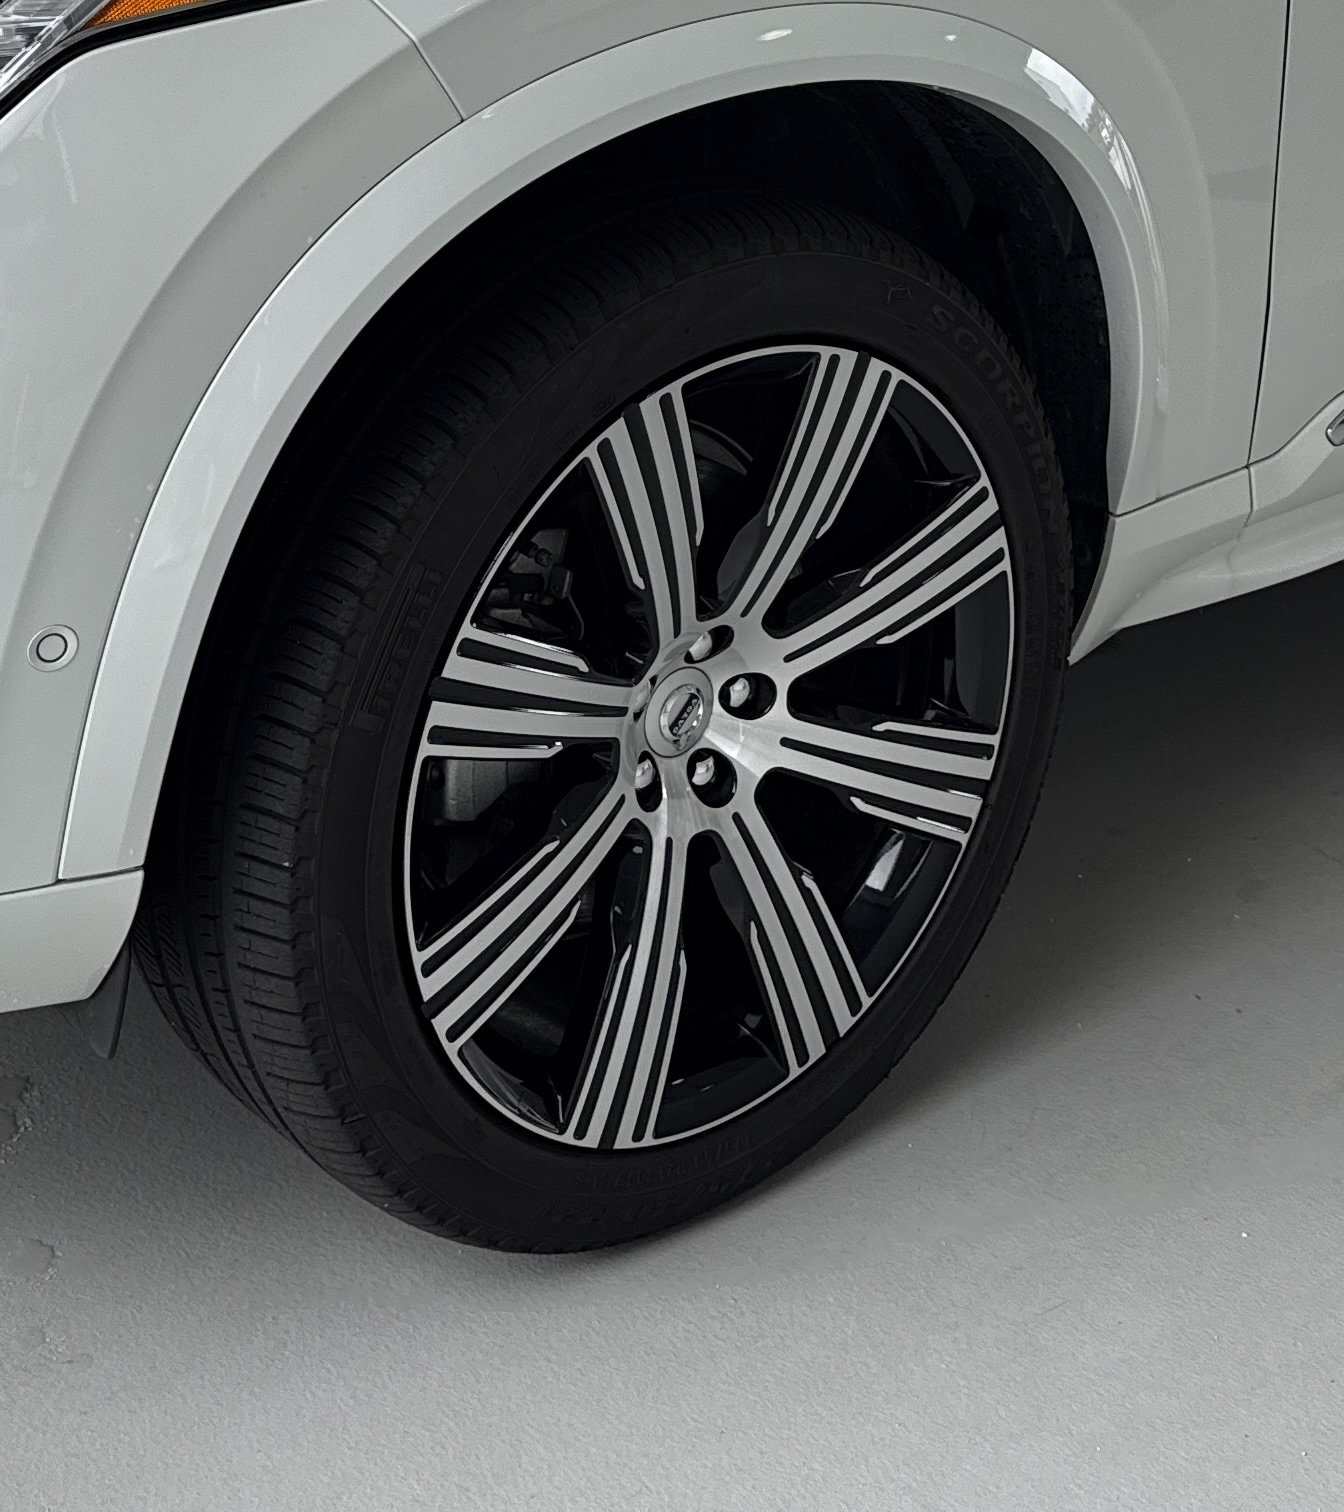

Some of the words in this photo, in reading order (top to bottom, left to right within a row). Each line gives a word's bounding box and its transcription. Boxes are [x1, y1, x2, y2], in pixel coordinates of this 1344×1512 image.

[928, 303, 1060, 535] SCORPION
[349, 562, 443, 734] PIRELLI
[672, 699, 698, 734] VOLVO
